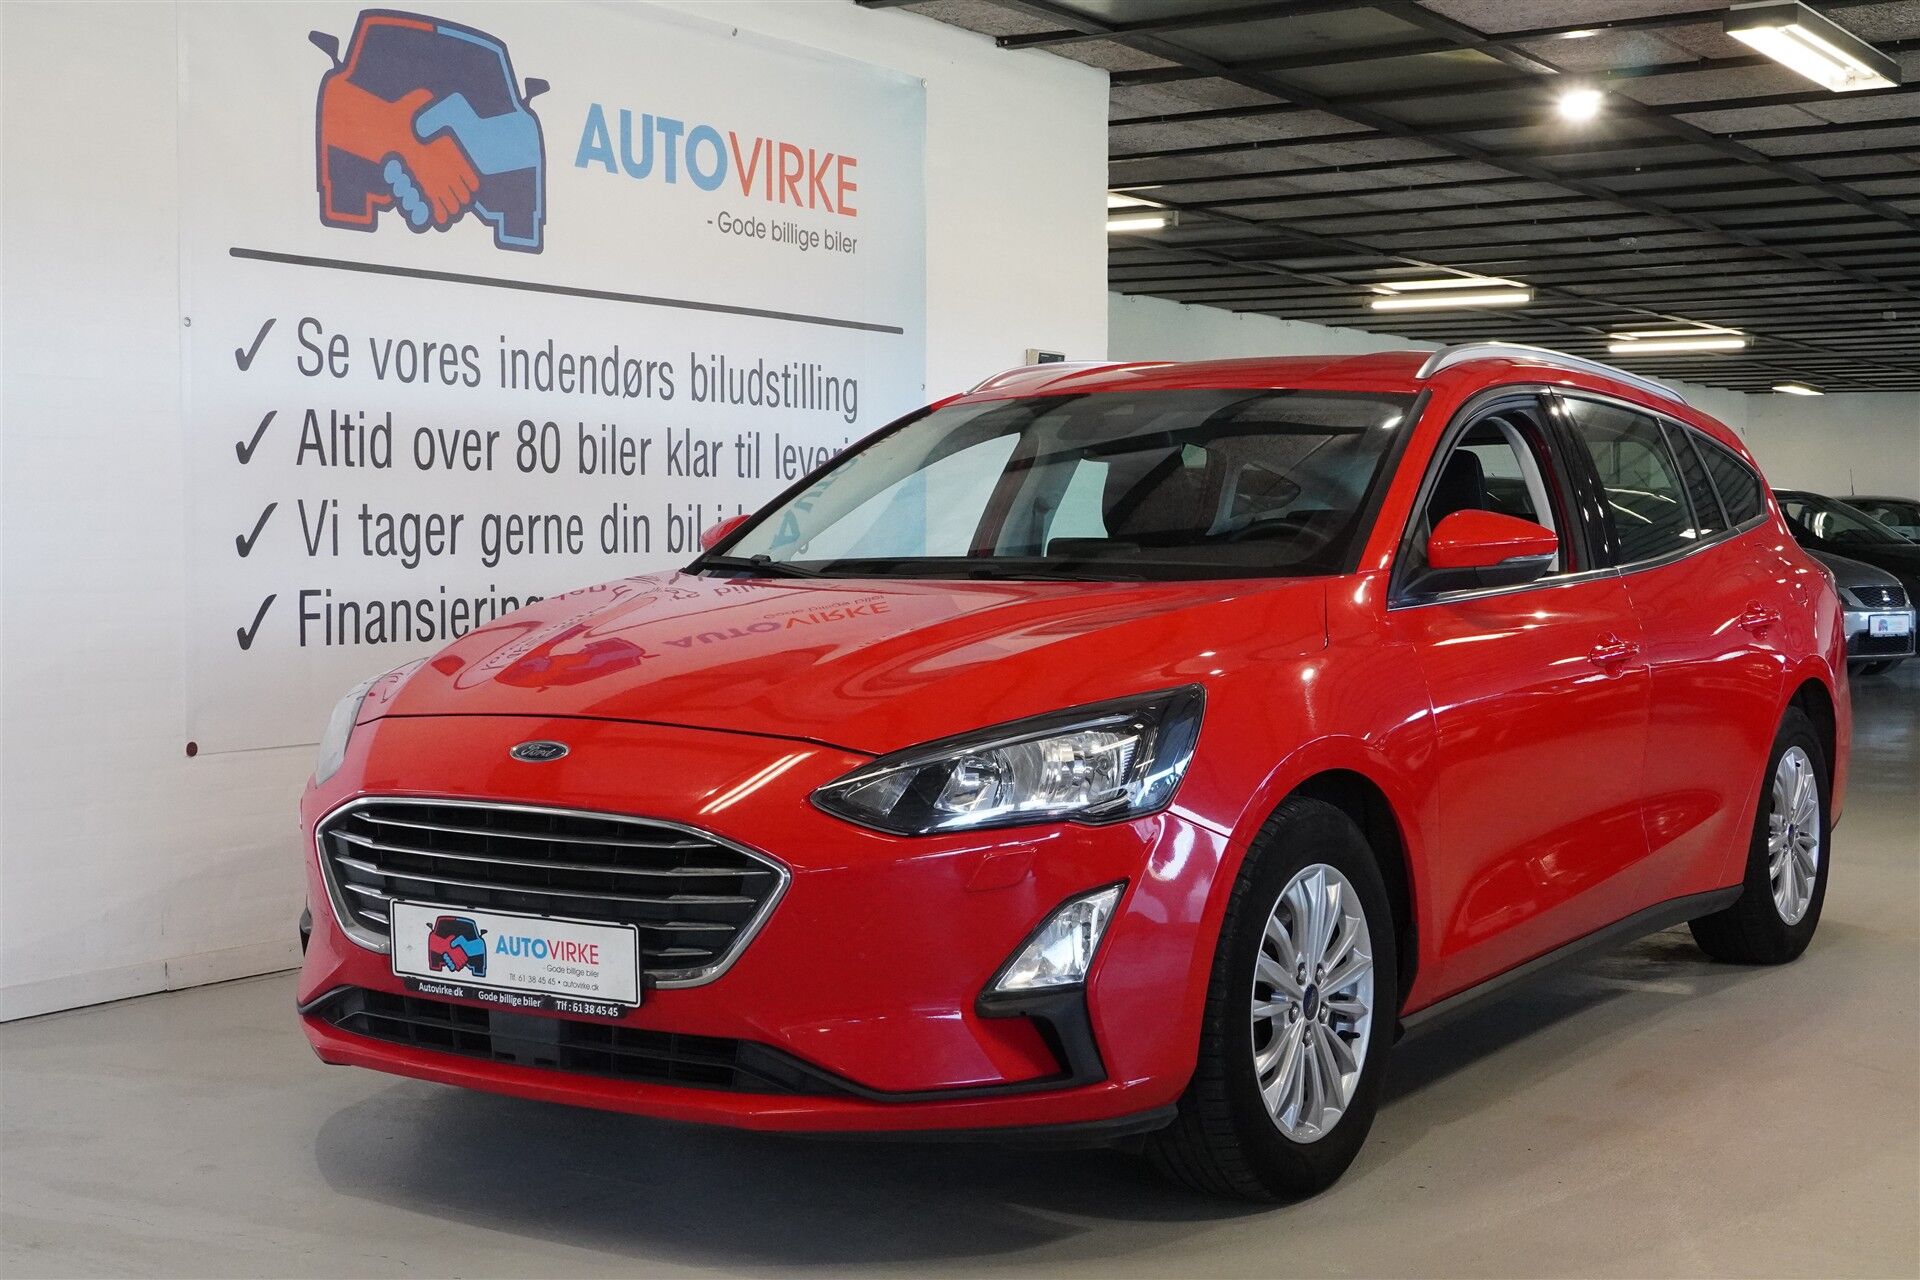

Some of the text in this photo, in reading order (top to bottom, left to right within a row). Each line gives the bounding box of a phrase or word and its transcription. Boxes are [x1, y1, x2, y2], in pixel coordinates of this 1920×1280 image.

[576, 103, 858, 218] AUTOVIRKE
[717, 210, 767, 239] Gode
[771, 219, 820, 251] billige
[824, 228, 858, 254] biler
[297, 316, 859, 423] Se vores indendørs biludstilling
[296, 408, 849, 481] Altid over 80 biler klar til leve
[297, 498, 702, 570] Vi tager gerne din bil
[299, 584, 544, 648] Finansieri
[495, 934, 600, 965] AUTOVIRKE
[546, 964, 600, 978] Gode billige biler
[418, 982, 453, 995] Autovirke
[478, 990, 499, 1003] Gode
[499, 992, 523, 1007] billige
[522, 996, 542, 1008] biler
[572, 1002, 583, 1013] 61
[584, 1003, 596, 1014] 38
[596, 1005, 607, 1016] 45
[607, 1007, 619, 1017] 45
[518, 974, 526, 982] 61
[528, 975, 537, 984] 38
[538, 976, 547, 985] 45
[547, 977, 556, 986] 45
